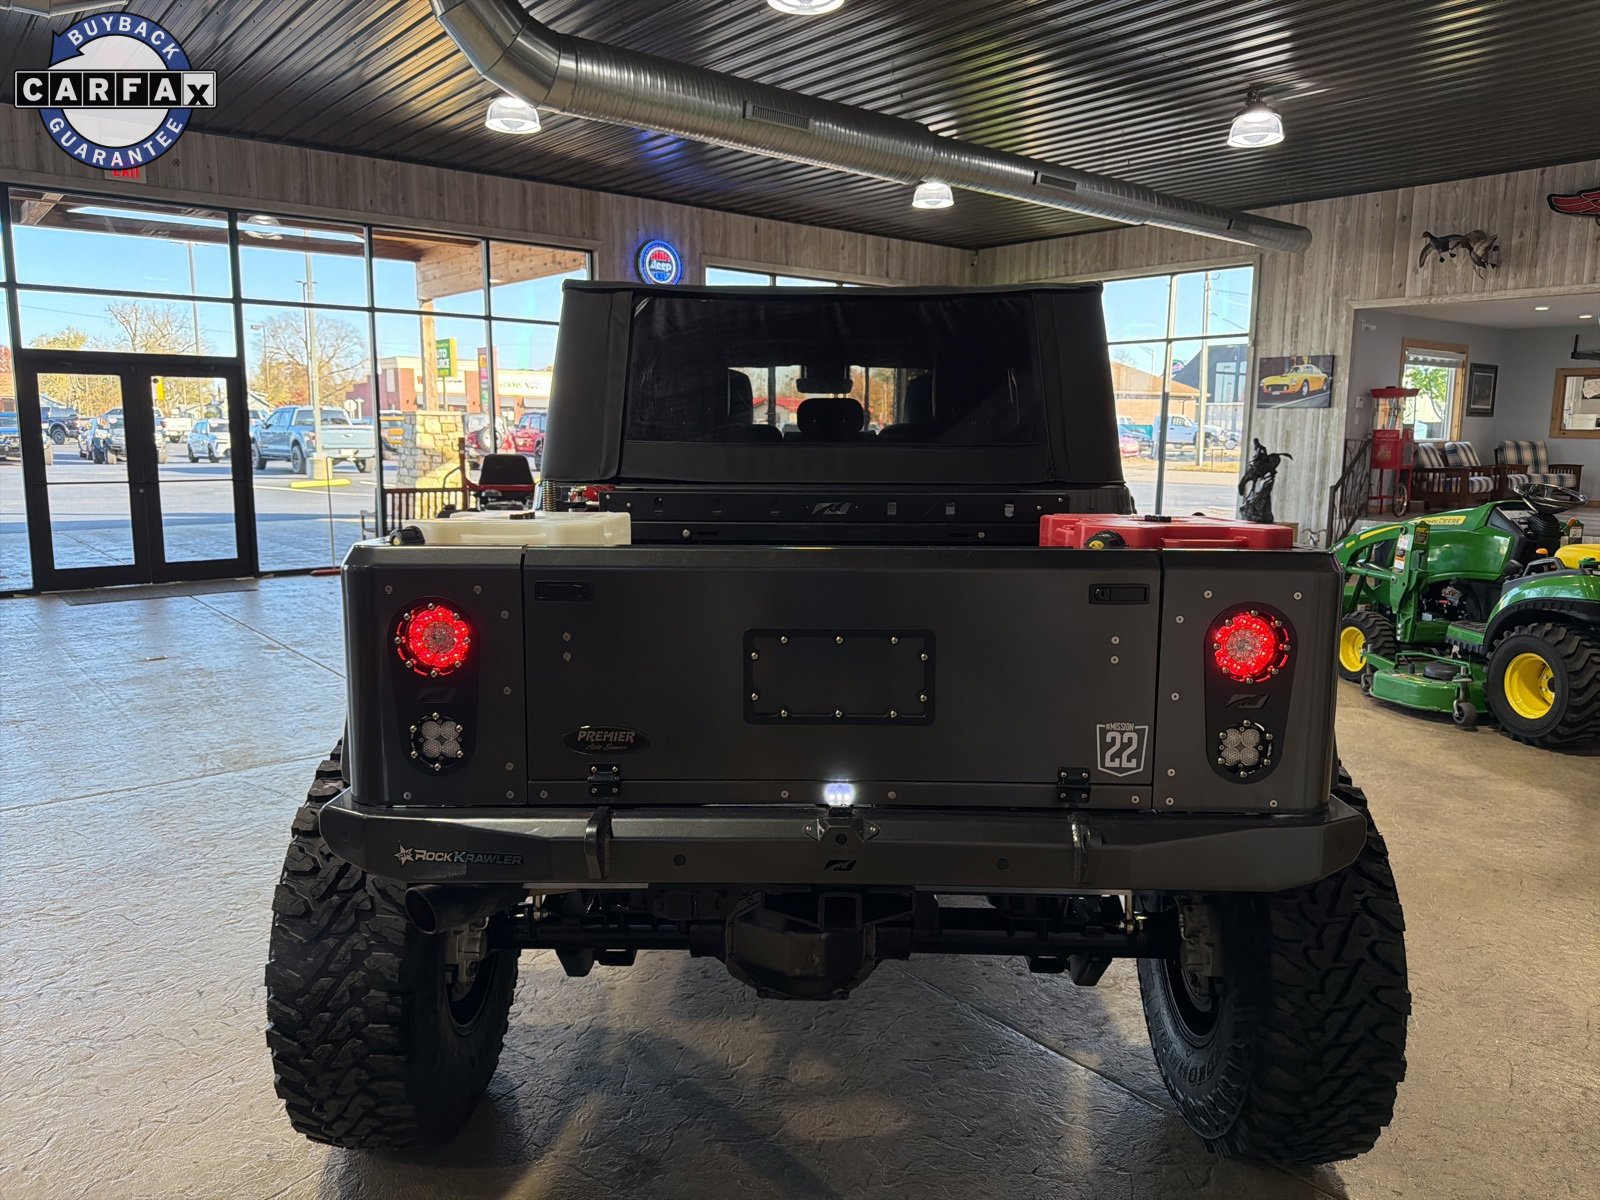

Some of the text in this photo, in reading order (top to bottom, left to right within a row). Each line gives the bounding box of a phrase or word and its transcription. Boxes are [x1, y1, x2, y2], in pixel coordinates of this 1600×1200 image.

[650, 259, 672, 272] Jeep
[1439, 517, 1462, 525] DEERE
[1105, 722, 1135, 731] #MISSION
[577, 730, 636, 743] PREMIER
[1104, 731, 1138, 768] 22
